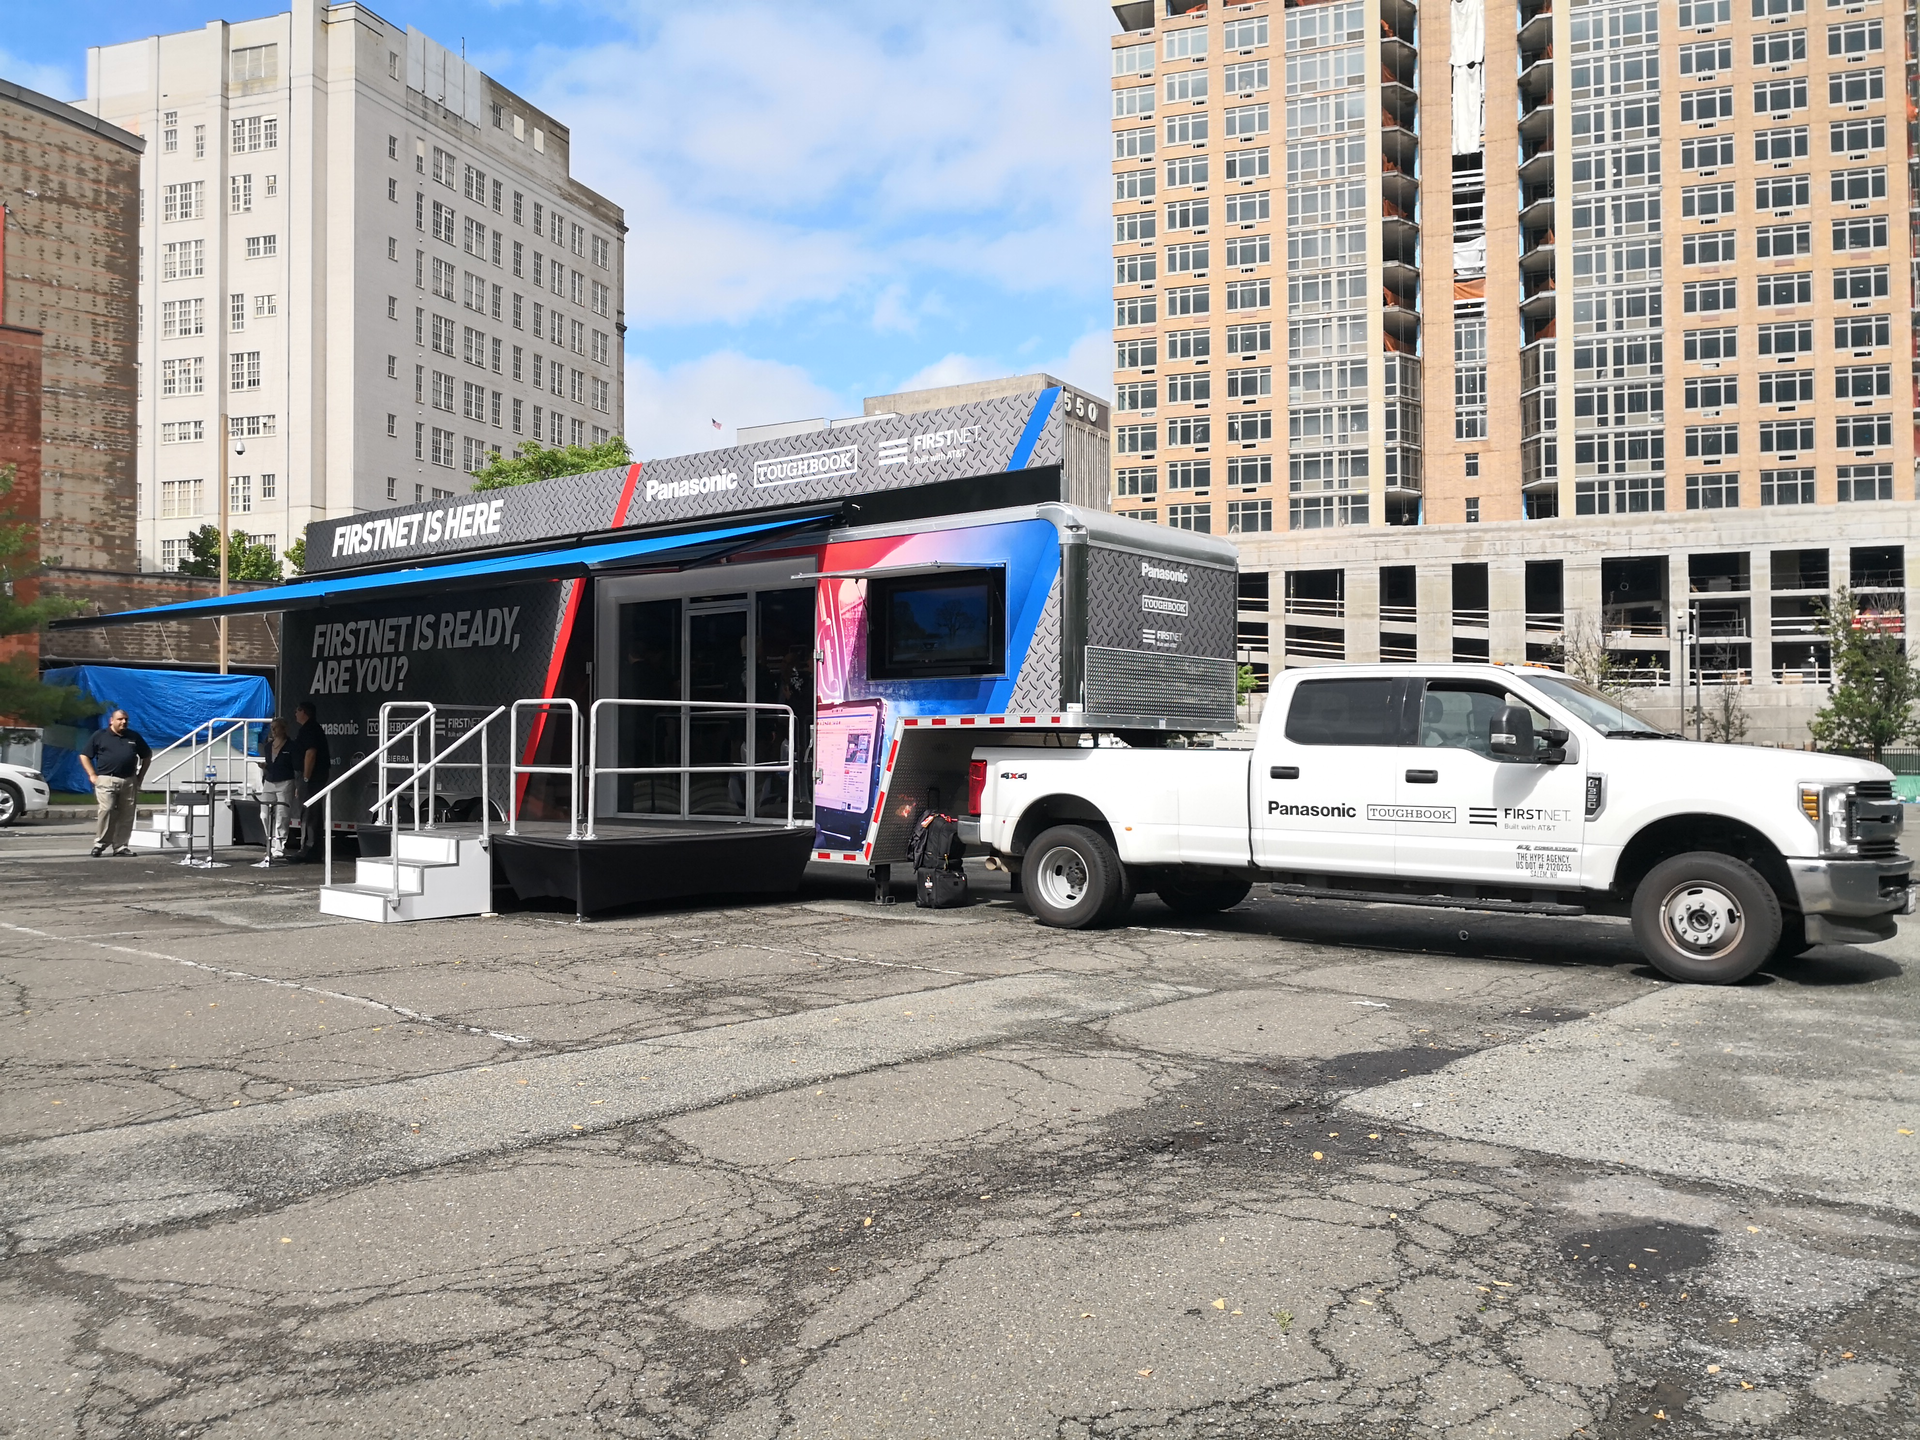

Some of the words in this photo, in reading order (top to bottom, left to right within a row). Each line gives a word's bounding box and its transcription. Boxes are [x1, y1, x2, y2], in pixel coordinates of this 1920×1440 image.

[1064, 391, 1097, 422] 550
[913, 454, 929, 465] Built
[930, 451, 946, 462] with
[946, 448, 967, 460] AT&T
[757, 453, 851, 482] TOUGHBOOK
[646, 468, 738, 502] Panasonic
[332, 512, 424, 558] FIRSTNET
[422, 509, 445, 544] IS
[444, 499, 505, 541] HERE
[1141, 562, 1188, 583] Panasonic
[1144, 598, 1186, 613] TOUGHBOOK
[312, 616, 412, 658] FIRSTNET
[412, 614, 436, 651] IS
[437, 606, 521, 653] READY,
[309, 659, 353, 695] ARE
[355, 655, 409, 693] YOU?
[320, 719, 359, 736] nasonic
[387, 754, 410, 763] SIERRA
[1268, 800, 1357, 818] Panasonic
[1370, 807, 1453, 820] TOUGHBOOK
[1504, 823, 1519, 831] Built
[1516, 861, 1524, 870] US
[1525, 861, 1536, 870] DOT
[1538, 862, 1544, 870] #
[1546, 863, 1572, 872] 2120235
[1517, 852, 1529, 862] THE
[1529, 853, 1545, 863] HYPE
[1546, 854, 1570, 864] AGENCY
